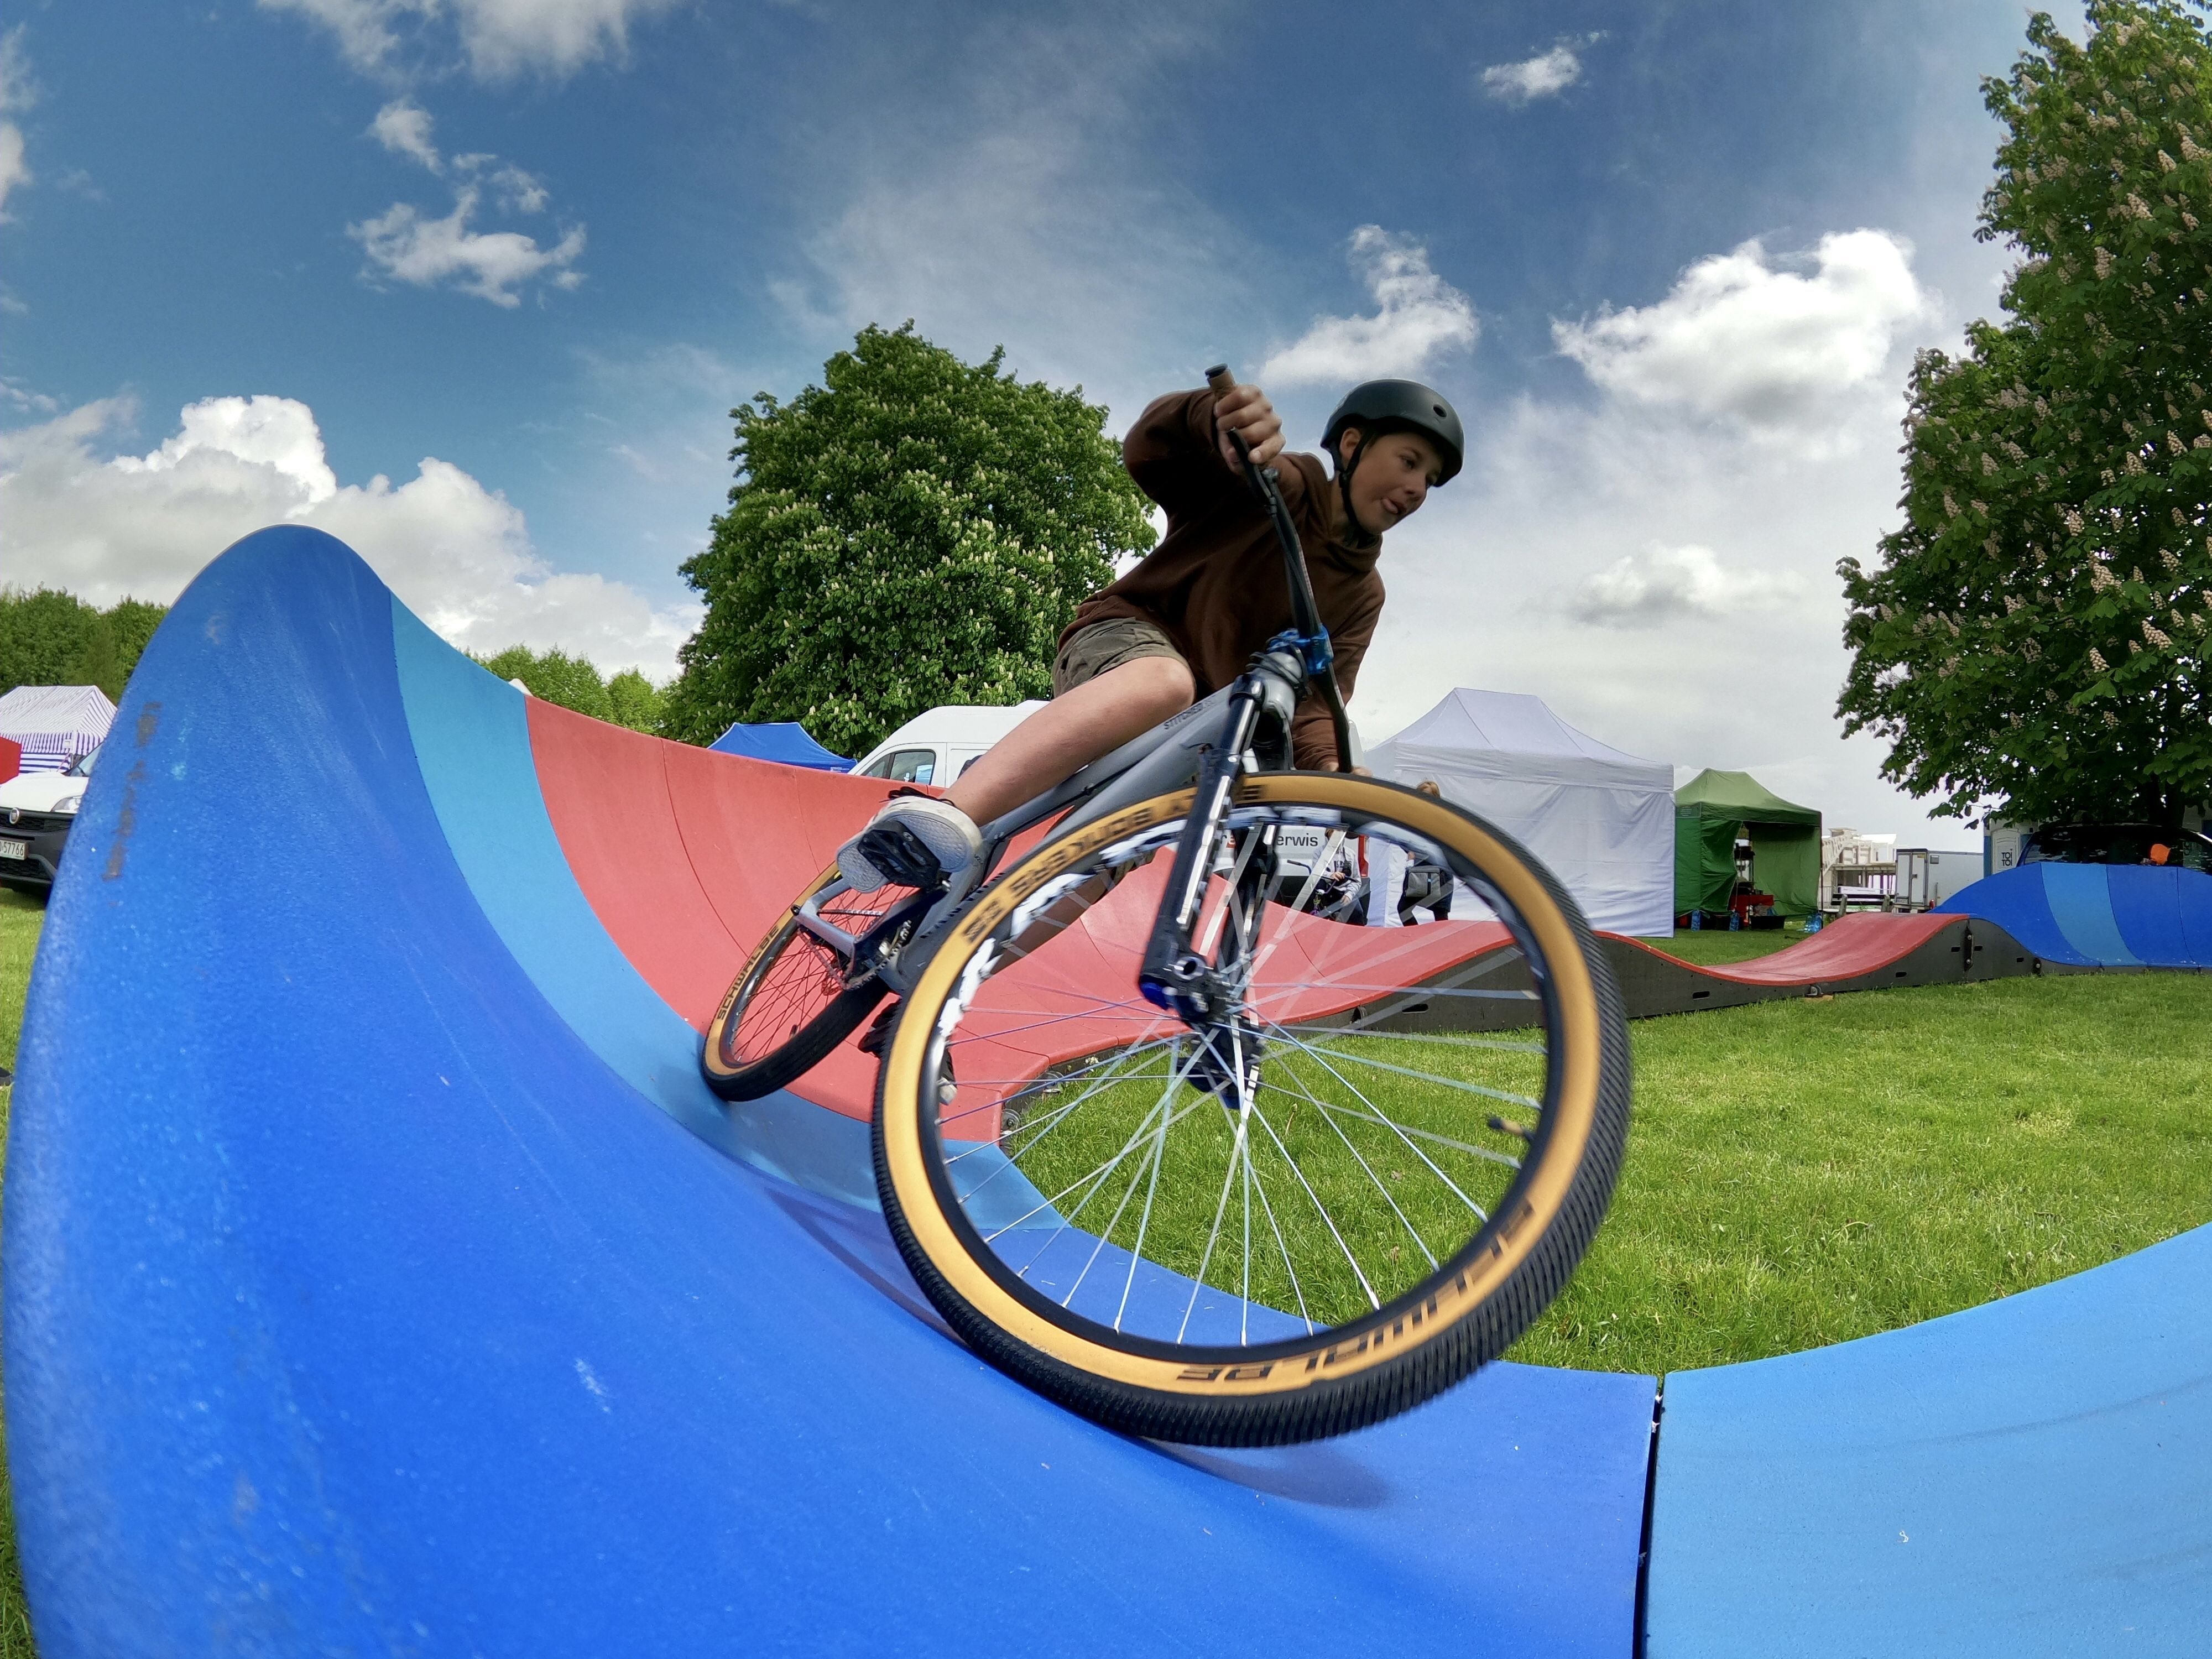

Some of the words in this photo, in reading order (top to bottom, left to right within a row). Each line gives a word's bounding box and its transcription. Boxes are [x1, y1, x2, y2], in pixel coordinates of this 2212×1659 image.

[1276, 833, 1318, 847] erwis
[3, 842, 24, 856] 57766
[717, 925, 779, 1020] SCHWALBE
